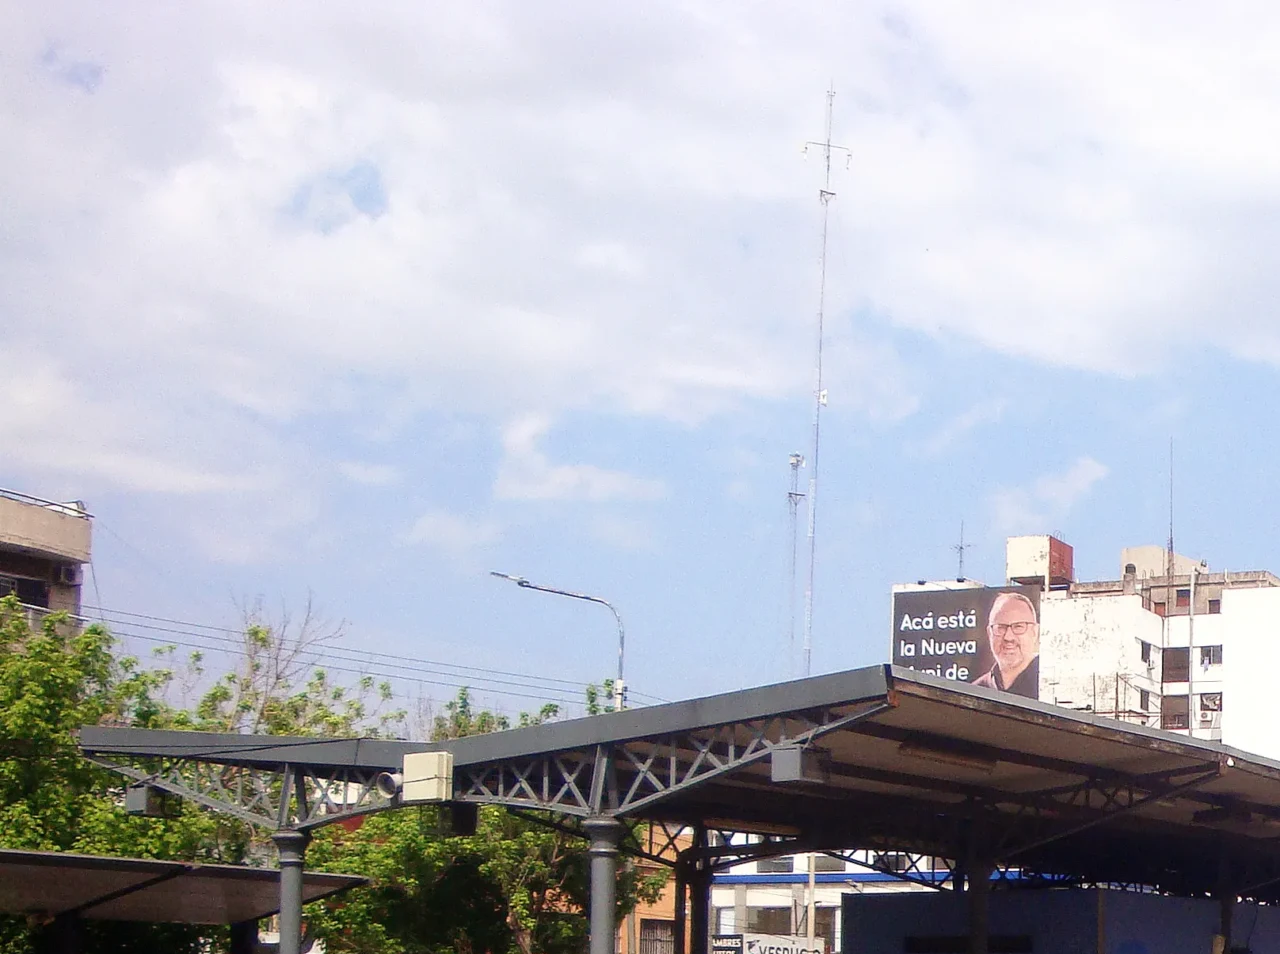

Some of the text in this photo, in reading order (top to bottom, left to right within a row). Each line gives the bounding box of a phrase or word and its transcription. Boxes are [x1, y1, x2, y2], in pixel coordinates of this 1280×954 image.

[900, 609, 976, 631] Acá está
[900, 638, 976, 657] la Nueva
[945, 663, 969, 680] de
